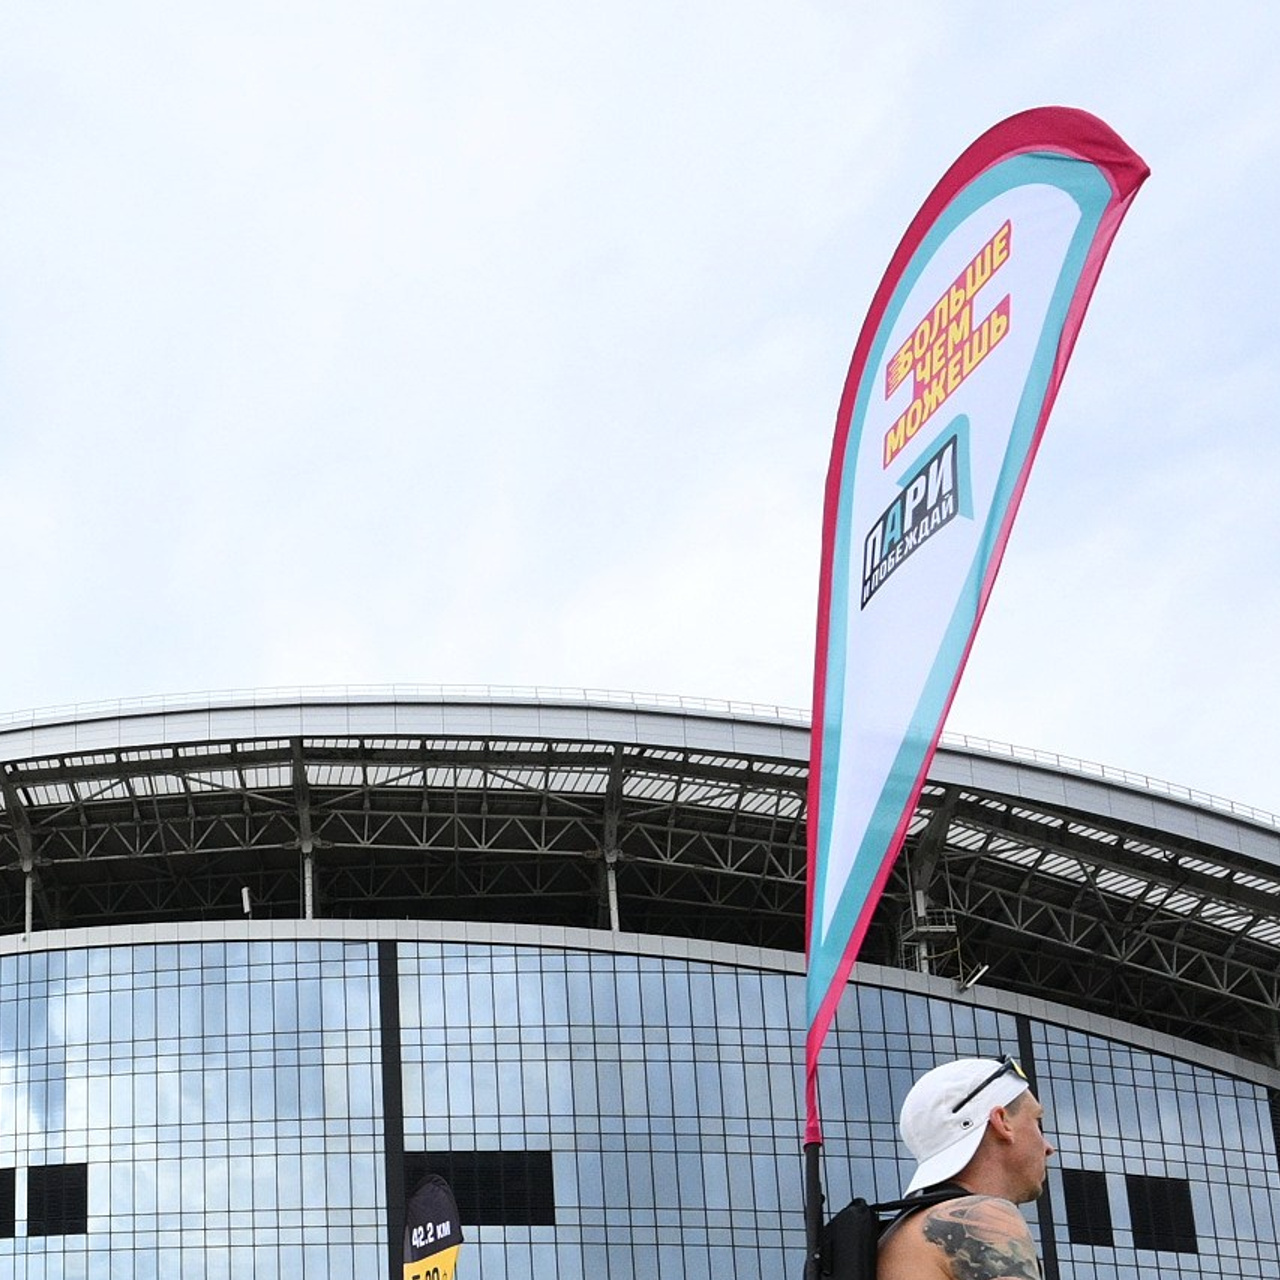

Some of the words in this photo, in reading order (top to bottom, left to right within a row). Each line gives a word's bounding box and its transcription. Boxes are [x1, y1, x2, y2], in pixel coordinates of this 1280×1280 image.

[888, 225, 1009, 393] БОЛЬШЕ
[915, 305, 970, 385] ЧЕМ
[885, 308, 1009, 467] МОЖЕШЬ
[865, 444, 954, 579] ПАРИ
[870, 494, 954, 593] ПОБЕЖДАЙ
[411, 1222, 435, 1249] 42.2
